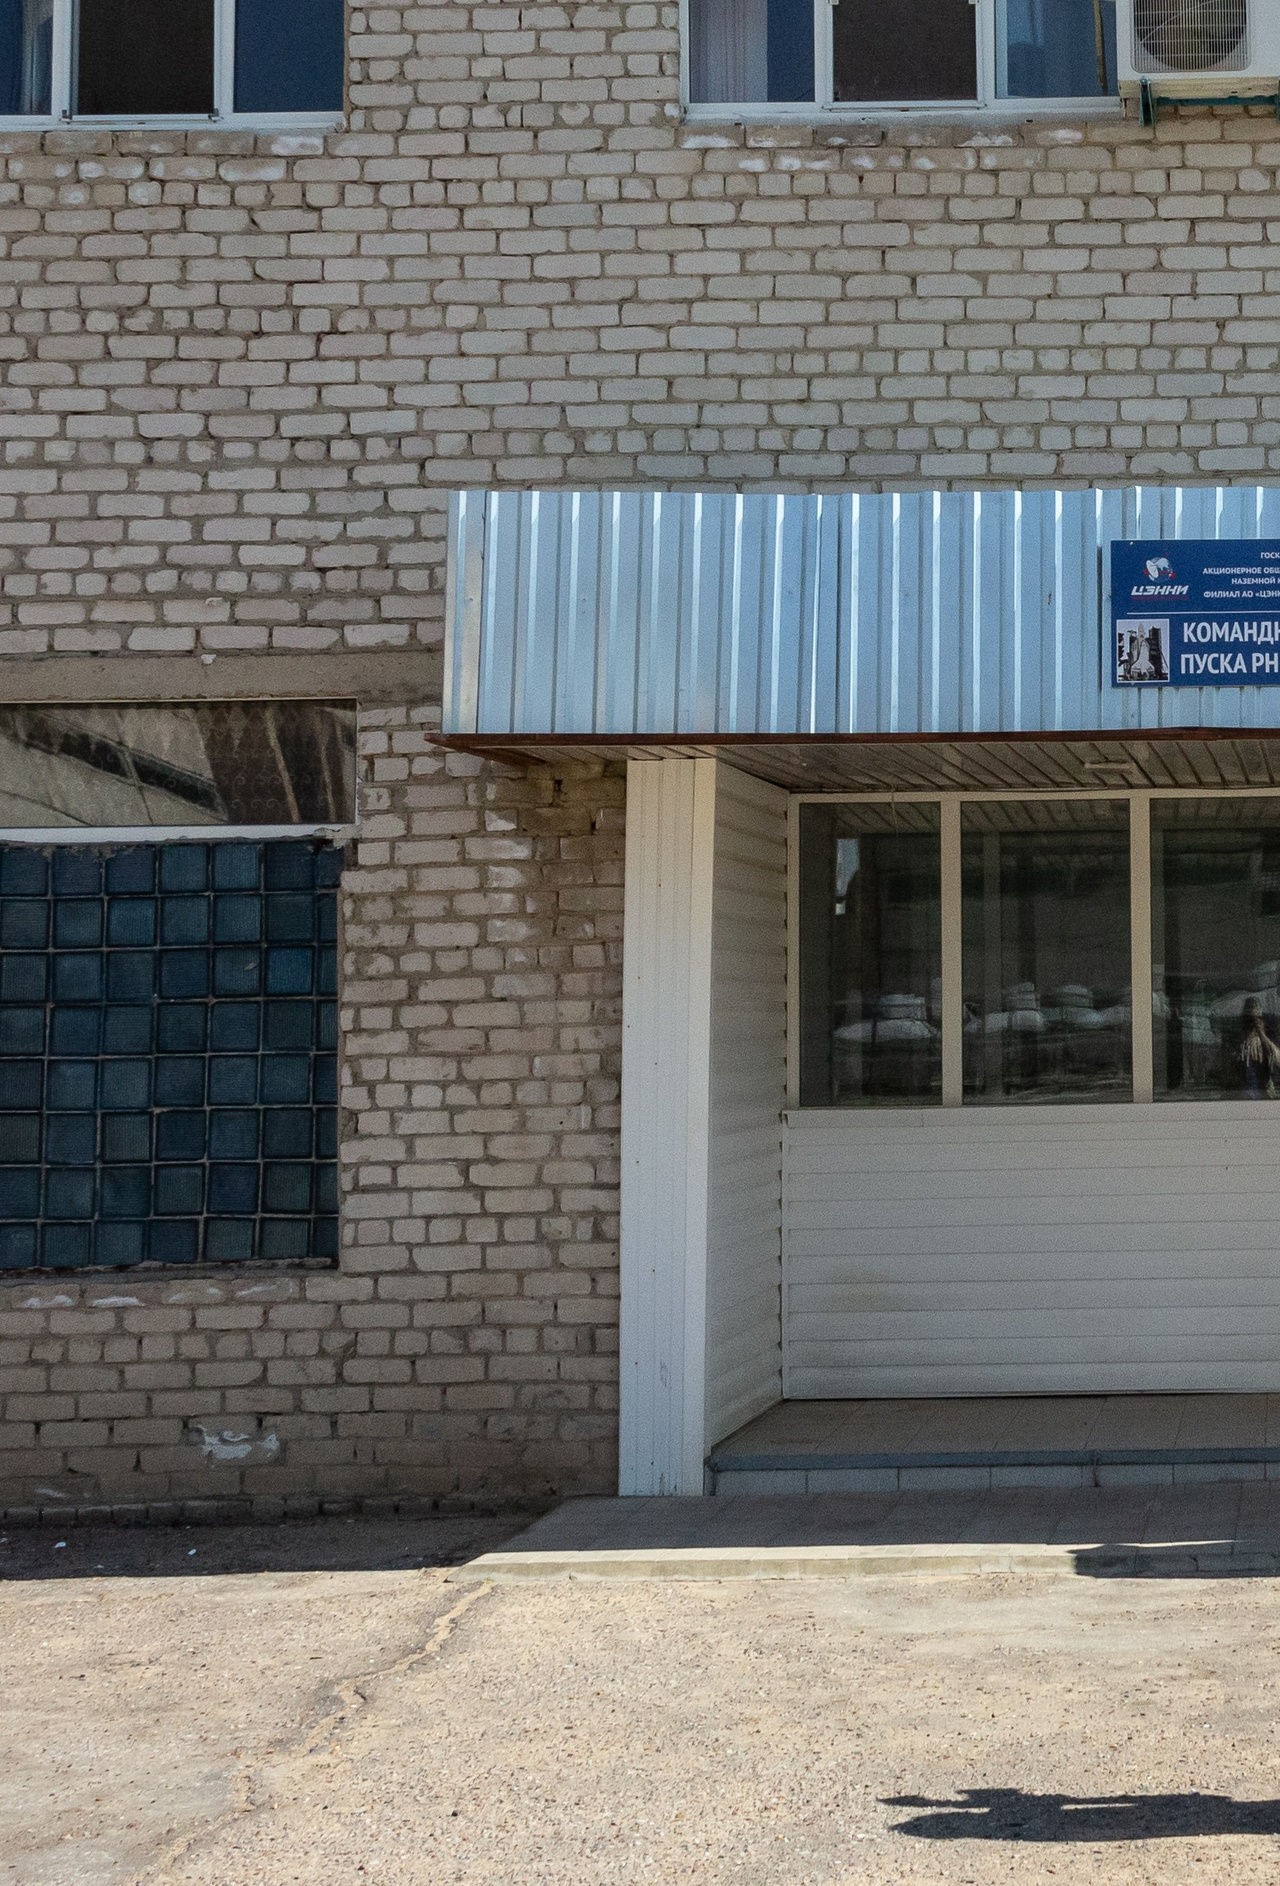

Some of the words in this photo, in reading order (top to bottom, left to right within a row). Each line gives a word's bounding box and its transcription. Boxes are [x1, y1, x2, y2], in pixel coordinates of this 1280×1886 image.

[1202, 566, 1262, 575] АКЦИОНЕРНОЕ
[1231, 576, 1276, 585] НАЗЕМНОЙ
[1203, 590, 1240, 598] ФИЛИАЛ
[1241, 590, 1254, 598] АО
[1180, 653, 1248, 674] ПУСКА
[1251, 653, 1279, 673] РН
